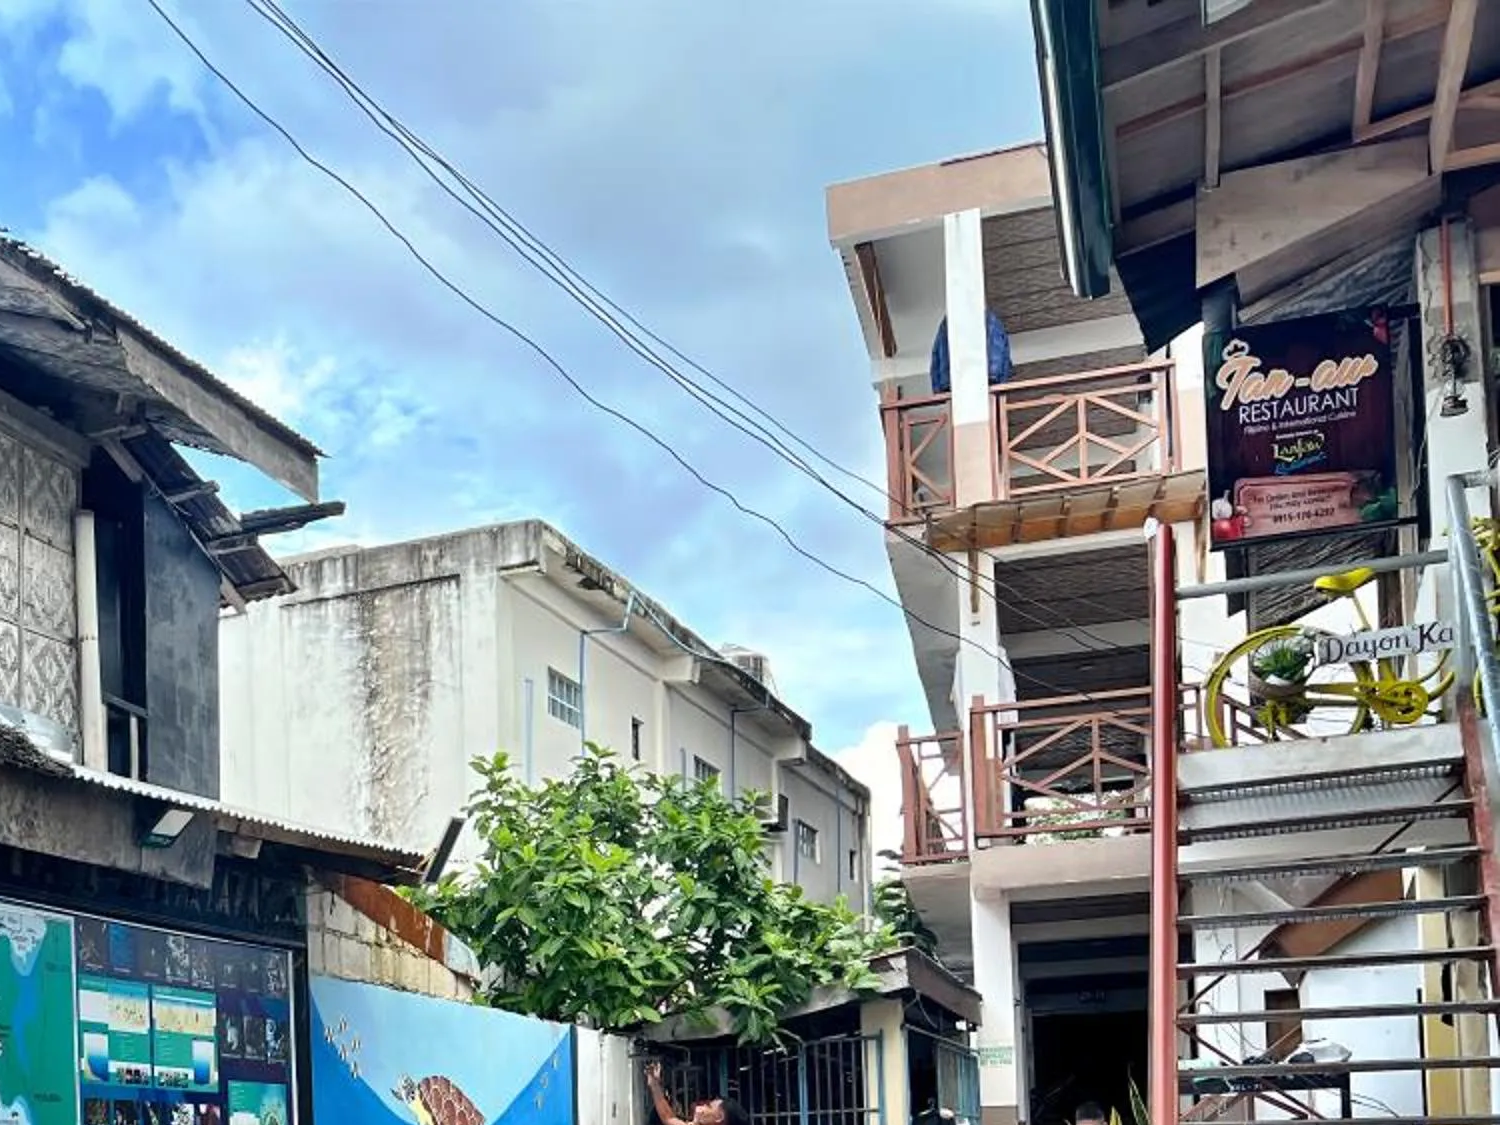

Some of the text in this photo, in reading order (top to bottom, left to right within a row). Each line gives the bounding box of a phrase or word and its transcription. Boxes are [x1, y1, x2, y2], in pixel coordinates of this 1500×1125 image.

[1216, 353, 1378, 410] Tan-aw
[1239, 388, 1359, 424] RESTAURANT
[1278, 415, 1327, 430] International
[1327, 621, 1454, 664] Dayon Ka
